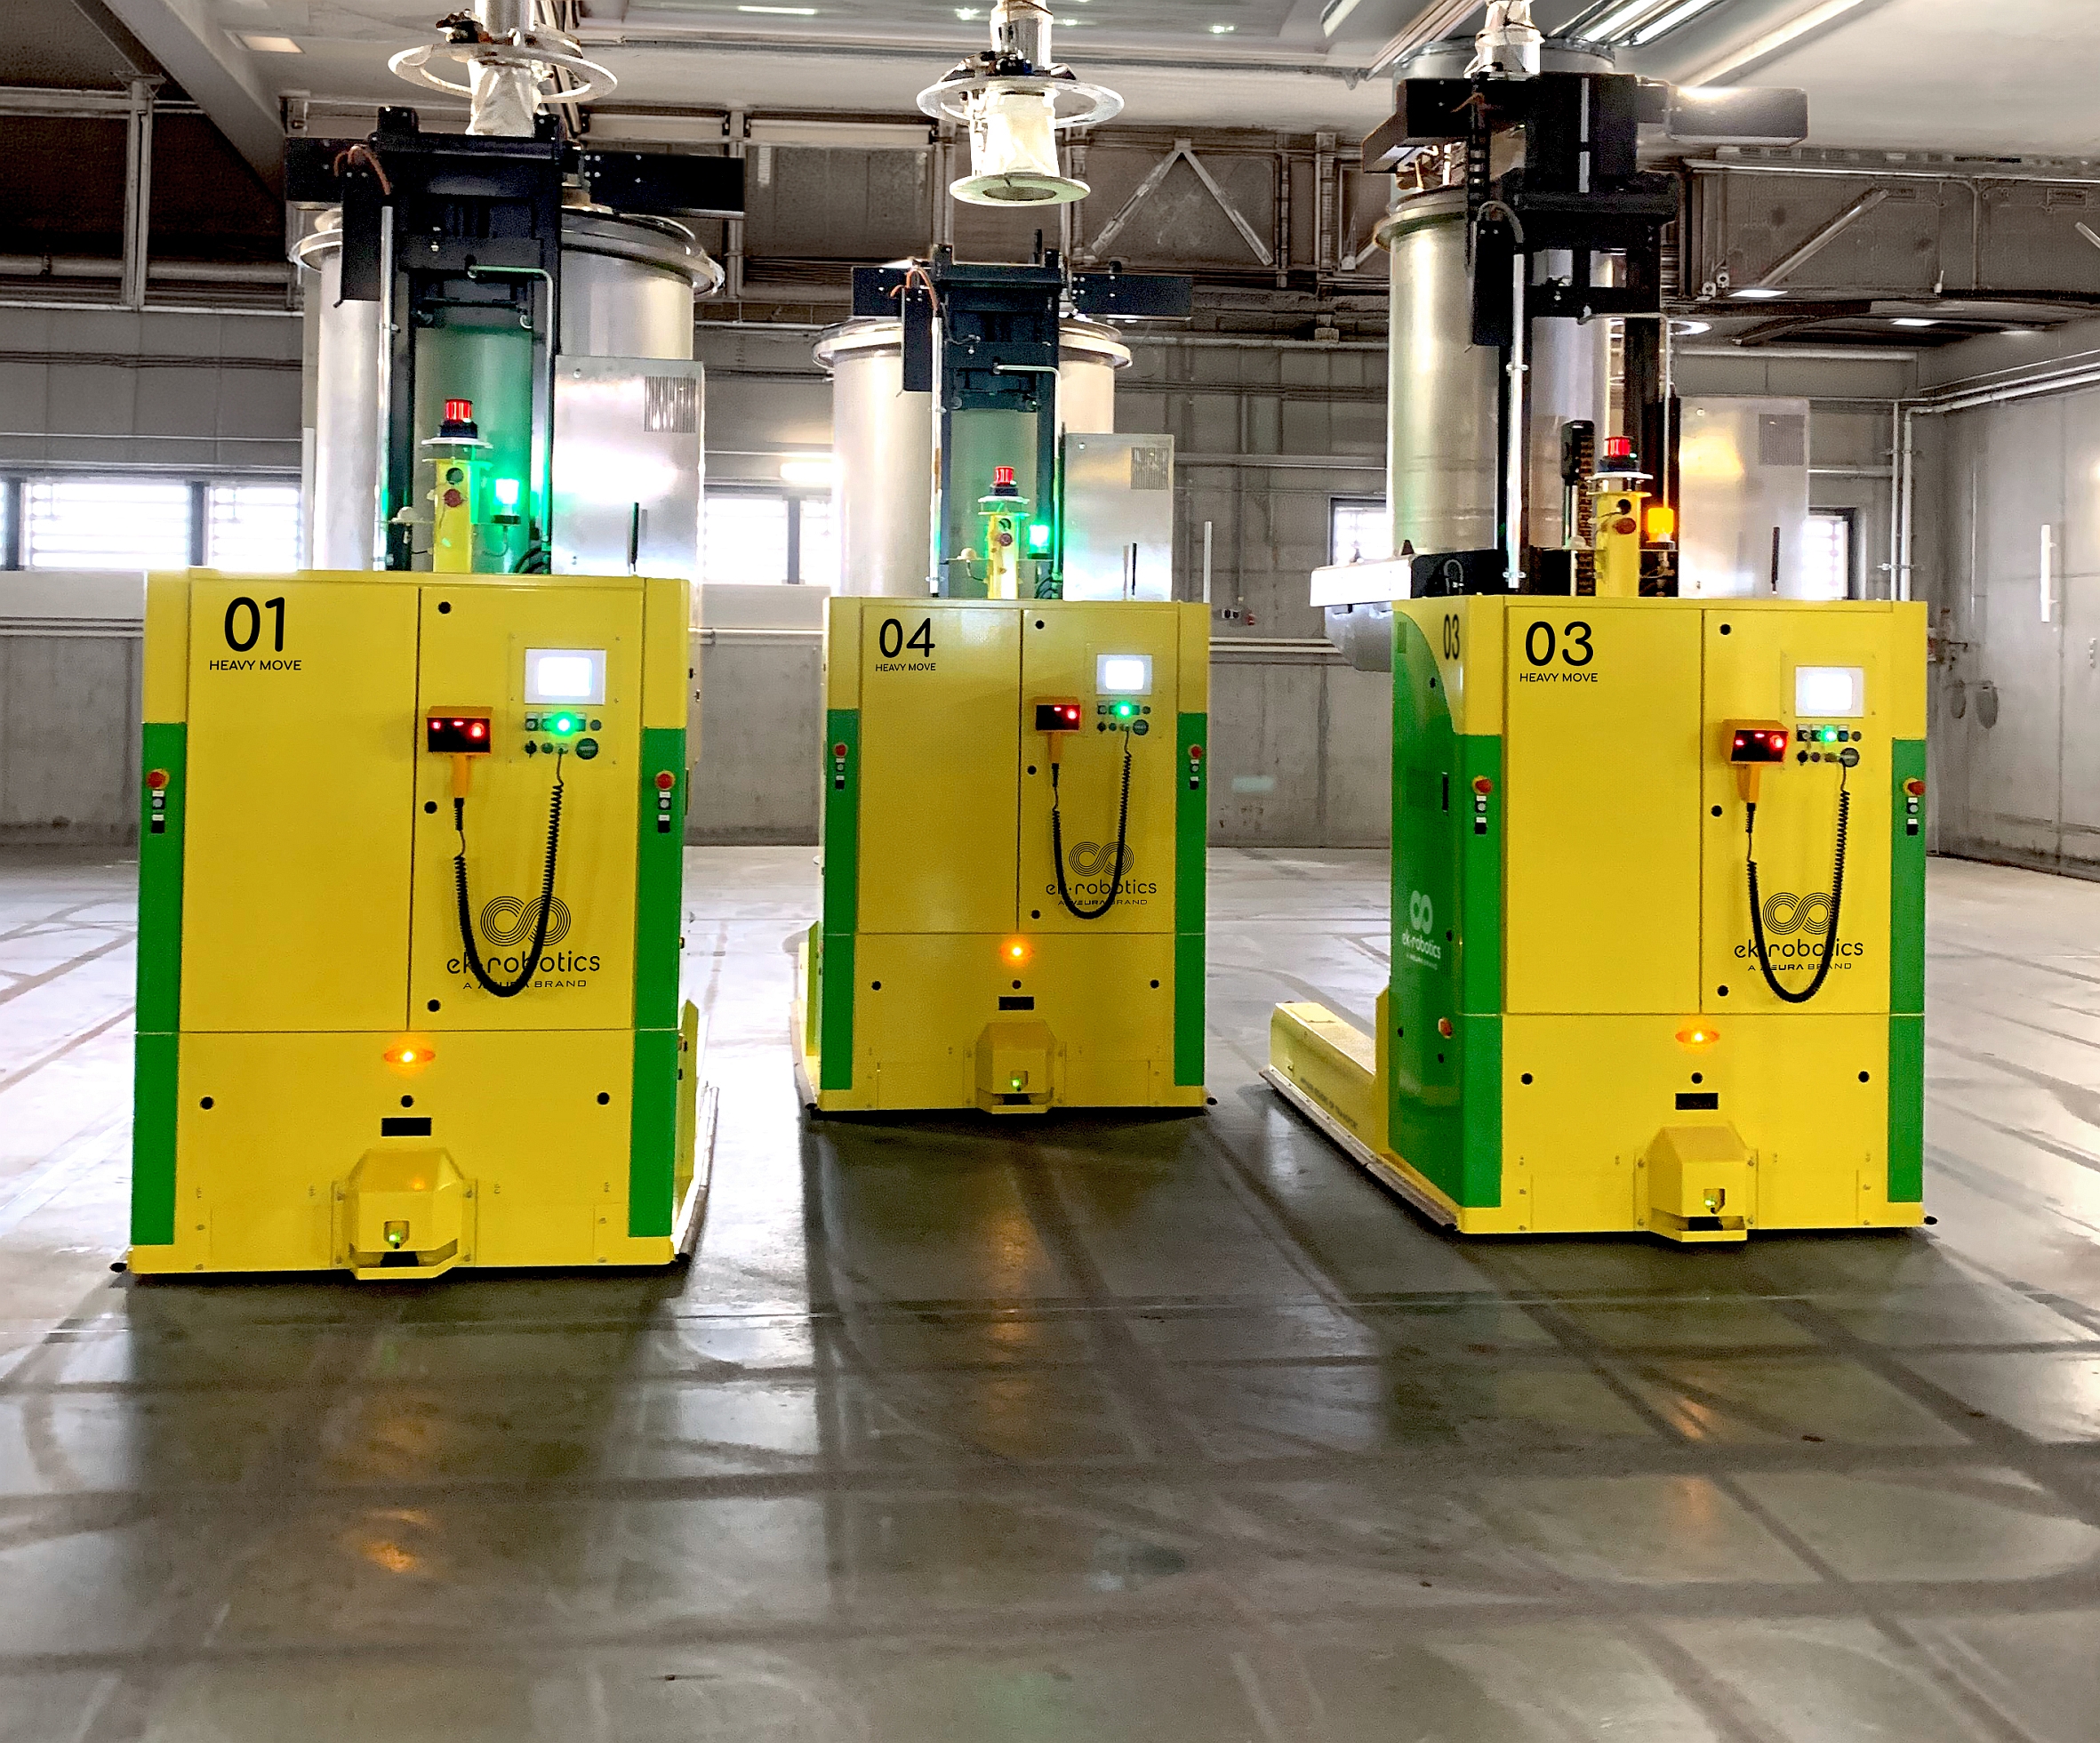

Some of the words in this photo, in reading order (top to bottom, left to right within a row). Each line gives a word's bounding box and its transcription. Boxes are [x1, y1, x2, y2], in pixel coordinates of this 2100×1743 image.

[224, 596, 285, 652] 01
[1443, 614, 1460, 660] 03
[879, 617, 935, 658] 04
[1525, 621, 1594, 666] 03
[209, 660, 256, 671] HEAVY
[260, 660, 302, 671] MOVE
[875, 663, 907, 672] HEAVY
[908, 663, 936, 671] MOVE
[1519, 672, 1559, 682] HEAVY
[1562, 672, 1598, 682] MOVE
[462, 982, 472, 990] A
[534, 980, 587, 988] BRAND
